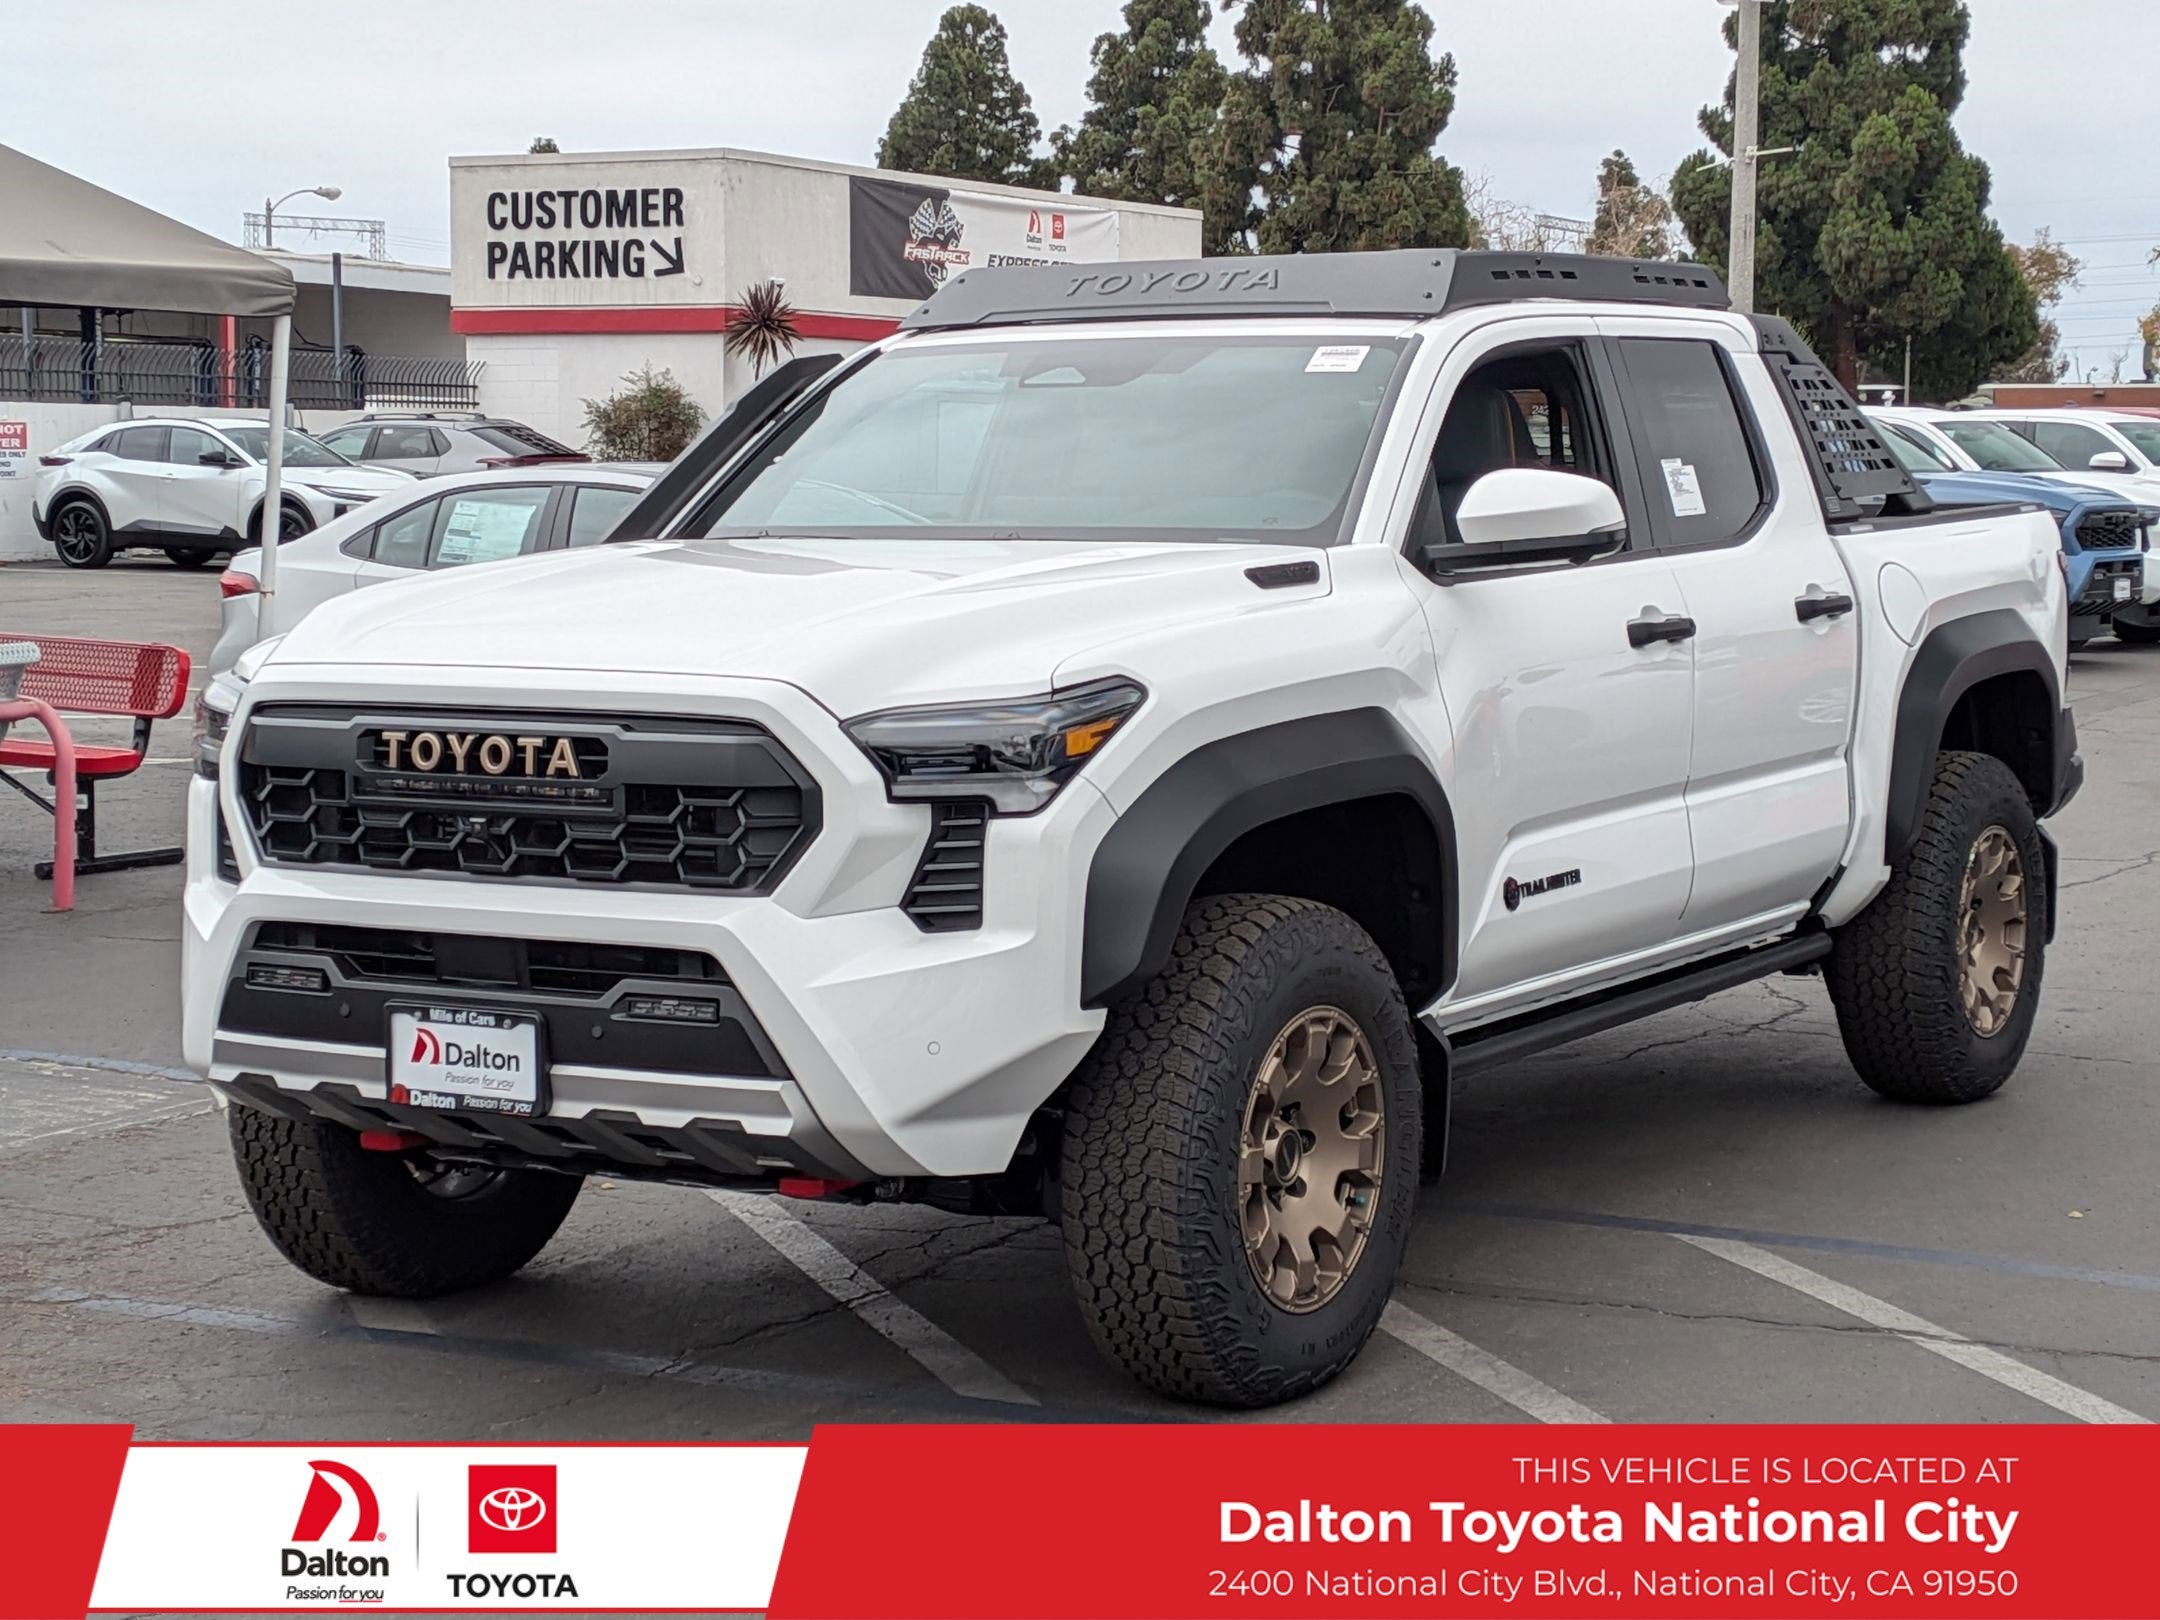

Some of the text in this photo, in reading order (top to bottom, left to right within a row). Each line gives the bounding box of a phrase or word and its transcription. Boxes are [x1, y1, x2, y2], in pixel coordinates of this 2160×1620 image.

[487, 188, 684, 230] CUSTOMER
[487, 239, 645, 279] PARKING
[1066, 268, 1280, 298] TOYOTA
[381, 731, 583, 779] TOYOTA
[429, 1008, 496, 1026] Mile of Cars
[445, 1042, 520, 1071] Dalton
[444, 1071, 515, 1089] Passion for you
[410, 1090, 533, 1114] Dalton Passion for you
